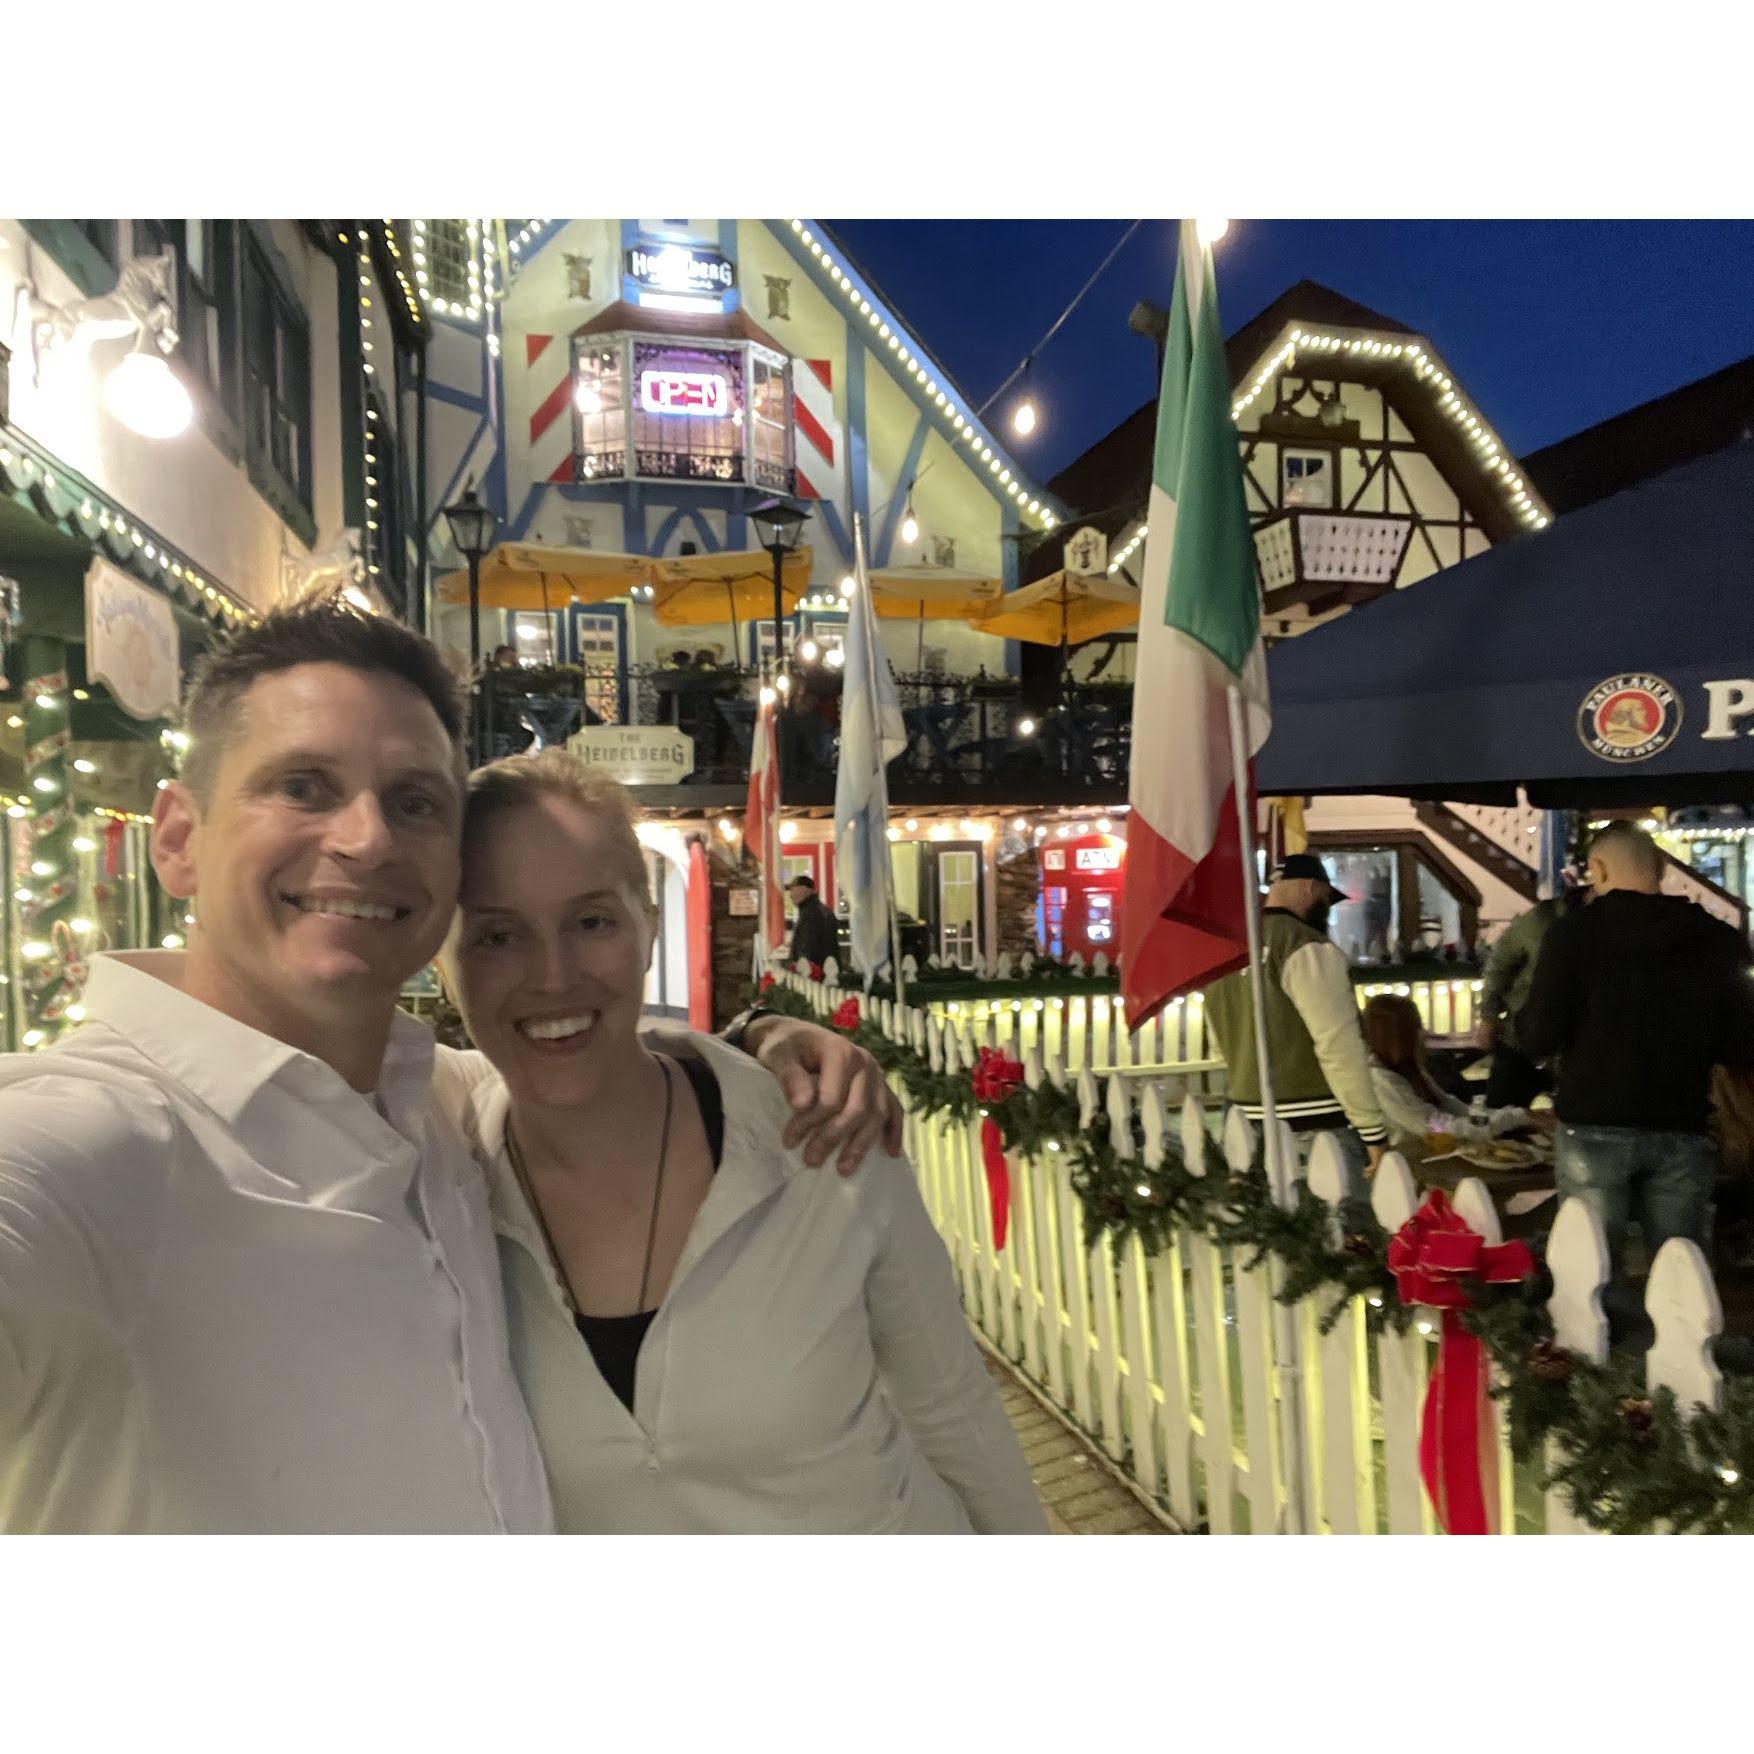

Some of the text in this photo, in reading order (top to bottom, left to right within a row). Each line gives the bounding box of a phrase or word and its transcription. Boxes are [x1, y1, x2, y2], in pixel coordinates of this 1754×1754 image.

[632, 249, 733, 287] HBERG
[647, 376, 722, 412] OPEN
[1586, 677, 1673, 711] PAULANER
[1701, 679, 1754, 740] P
[576, 743, 684, 766] HEIDELBERG
